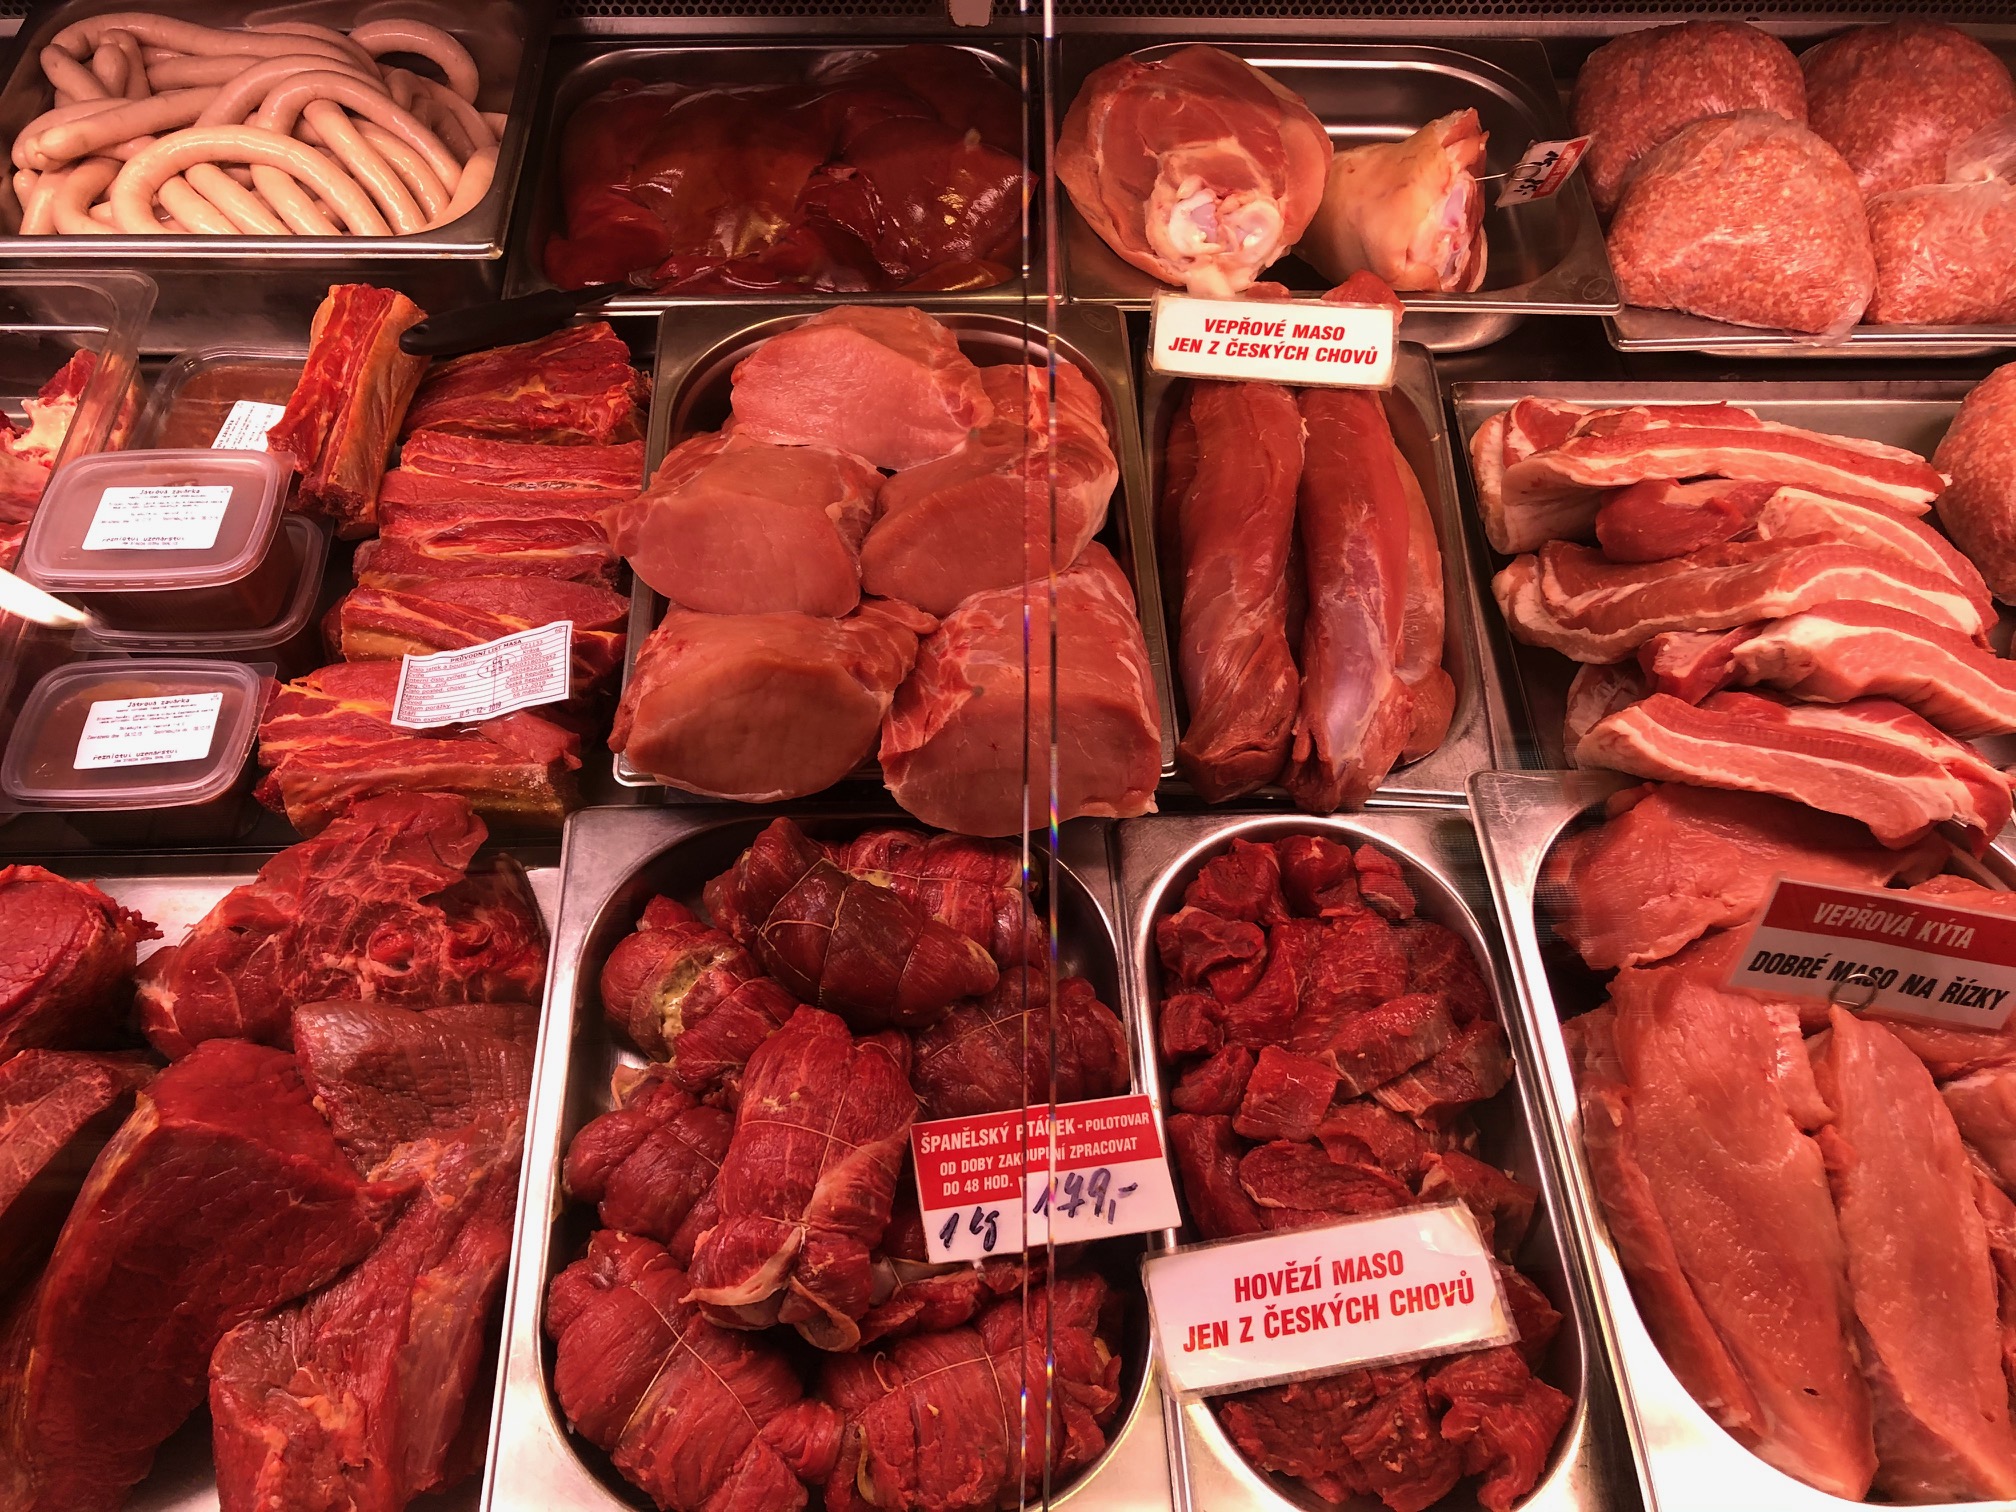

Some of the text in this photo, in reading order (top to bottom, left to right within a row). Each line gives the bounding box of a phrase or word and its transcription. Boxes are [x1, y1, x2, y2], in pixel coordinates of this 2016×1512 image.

[1204, 317, 1345, 341] VEPŘOVÉ MASO
[1168, 337, 1378, 365] JEN Z ČESKÝCH CHOVŮ
[450, 639, 522, 663] PRŮVODNÍ LIST MASA
[1812, 901, 1976, 950] VEPŘOVÁ KÝTA
[1747, 953, 2010, 1011] DOBRÉ MASO NA ŘÍZKY
[920, 1121, 1009, 1154] ŠPANĚLSKÝ
[1085, 1112, 1150, 1132] POLOTOVAR
[939, 1160, 956, 1176] OD
[961, 1154, 992, 1174] DOBY
[1069, 1136, 1138, 1159] ZPRACOVAT
[943, 1174, 1013, 1197] DO 48 HOD.
[939, 1212, 960, 1249] 1
[968, 1205, 1000, 1253] kg
[1234, 1249, 1404, 1304] HOVĚZÍ MASO
[1183, 1269, 1475, 1353] JEN Z ČESKÝCH CHOVŮ
